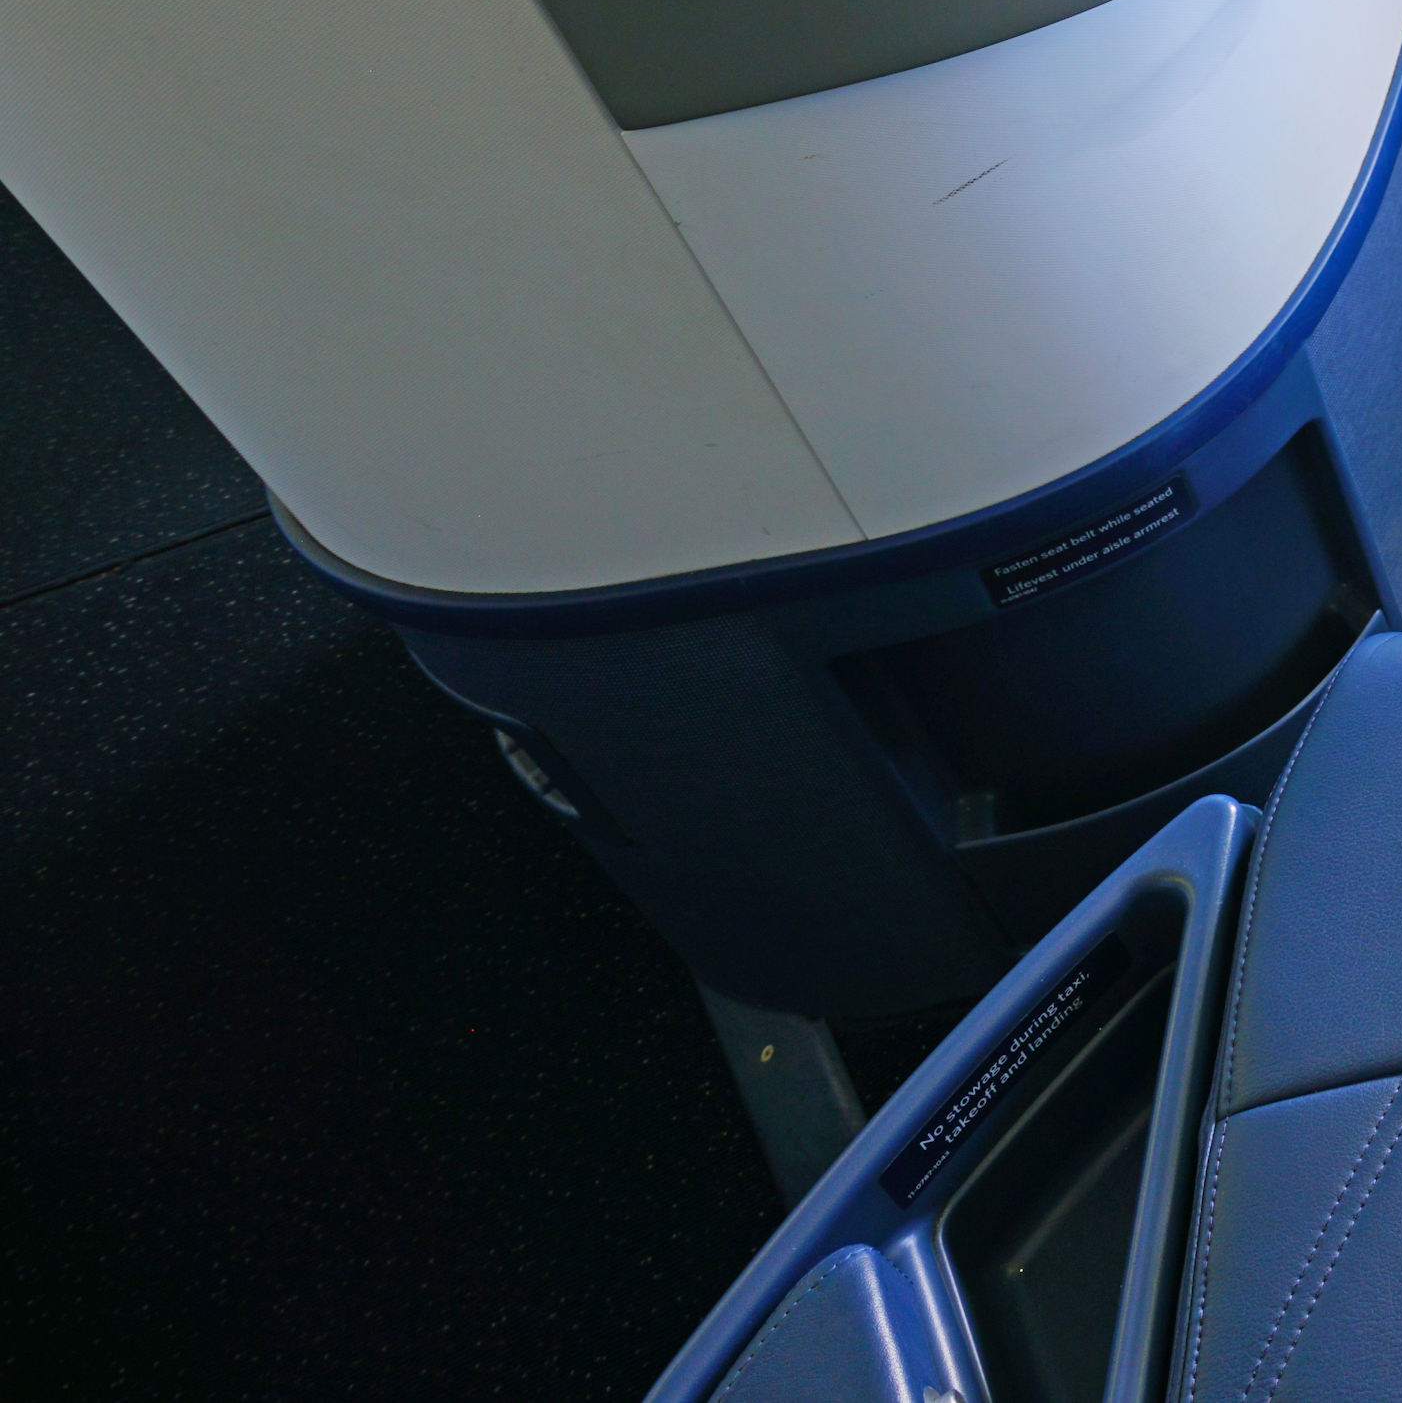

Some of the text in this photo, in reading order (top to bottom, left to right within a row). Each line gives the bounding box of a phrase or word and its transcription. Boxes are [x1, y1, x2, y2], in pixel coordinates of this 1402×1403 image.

[993, 486, 1174, 578] Fasten seat belt while seated
[1006, 568, 1060, 595] Lifevest
[1062, 551, 1100, 574] under
[1102, 534, 1132, 555] aisle
[1133, 506, 1181, 540] armrest
[919, 971, 1091, 1151] No stowage during taxi,
[945, 996, 1084, 1143] takeoff and landing
